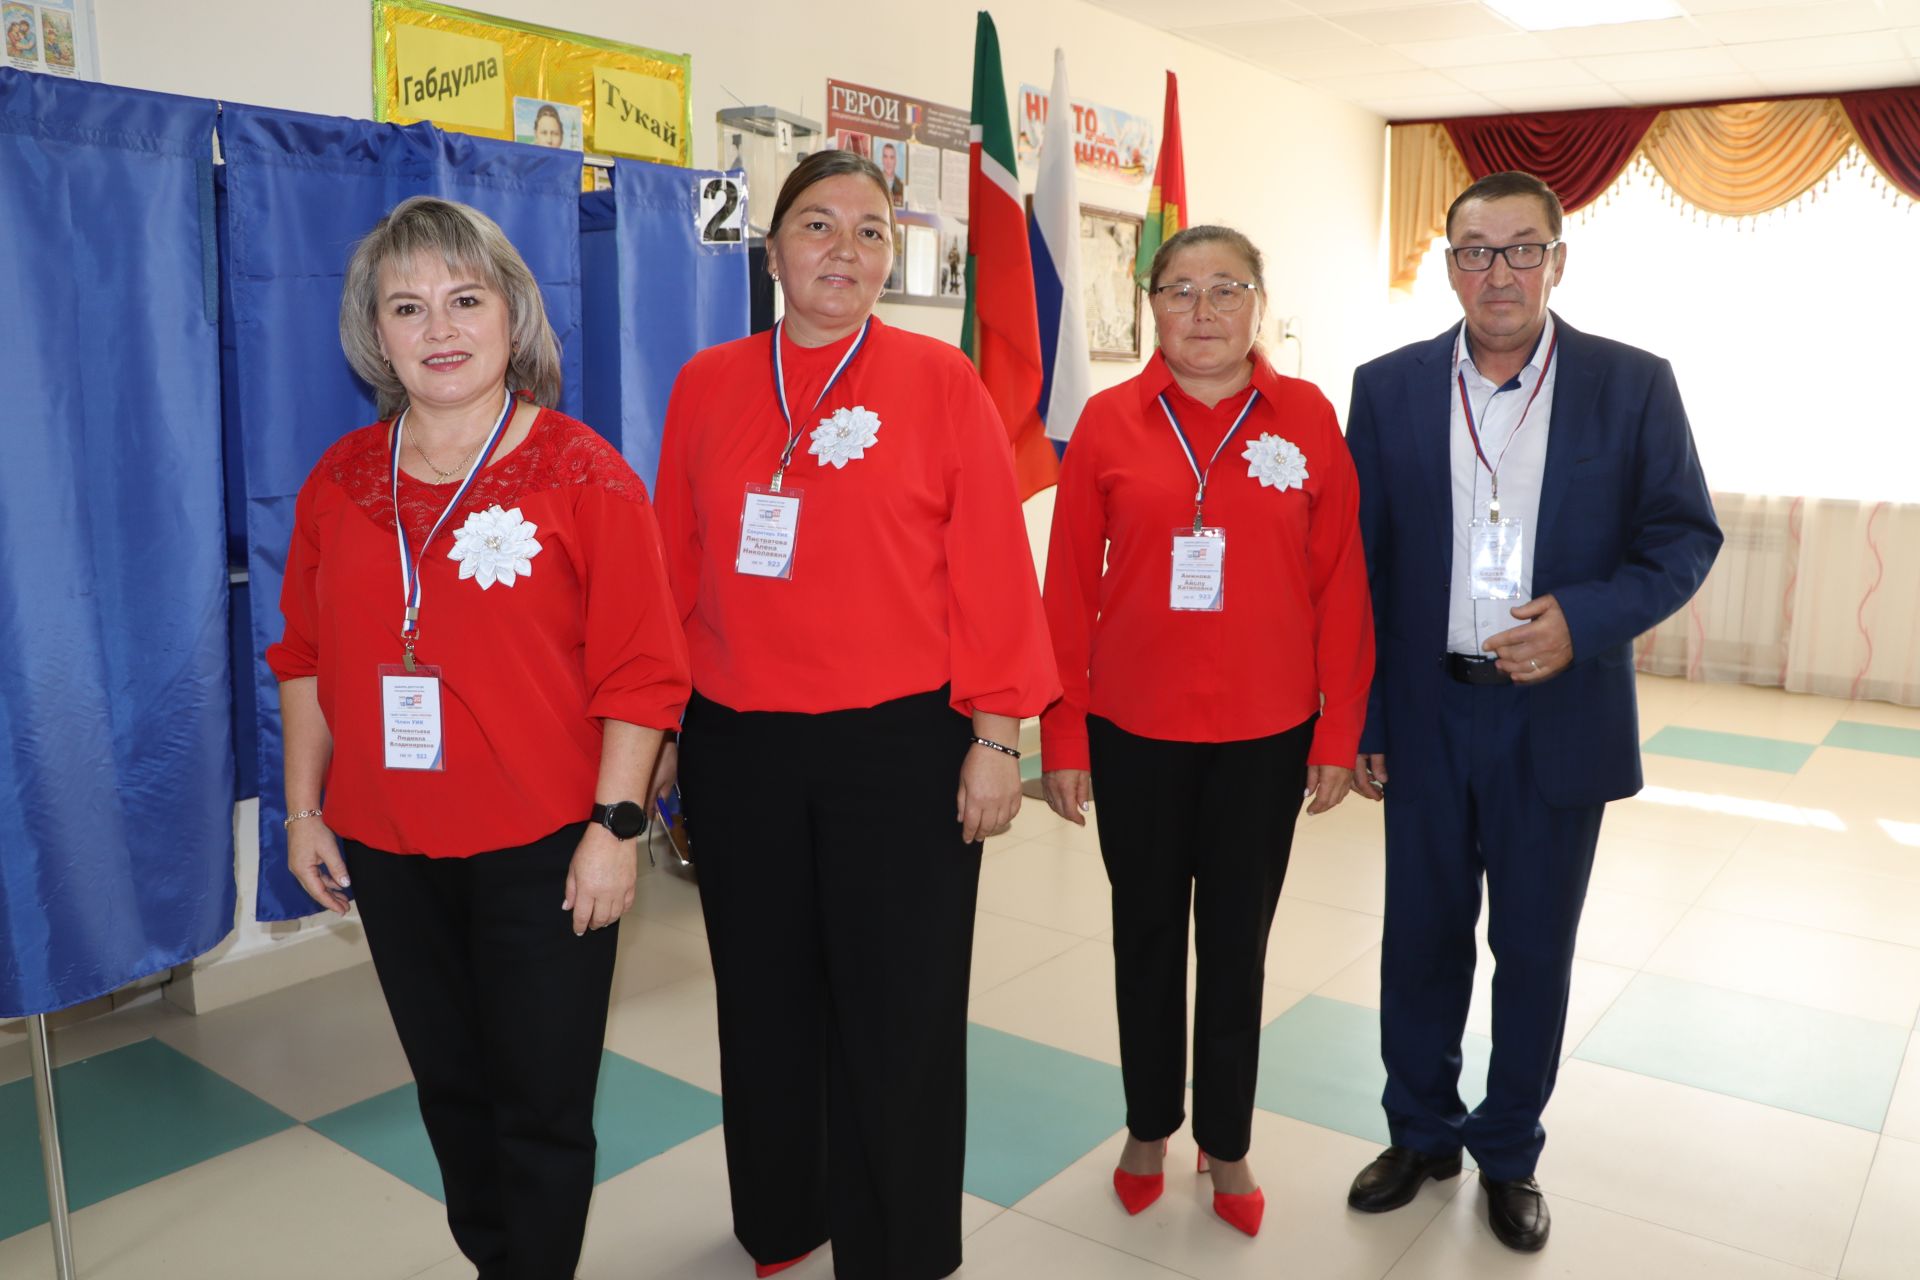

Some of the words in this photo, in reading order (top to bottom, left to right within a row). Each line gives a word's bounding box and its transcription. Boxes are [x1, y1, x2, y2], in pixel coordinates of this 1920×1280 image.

[403, 57, 498, 105] Габдулла
[602, 79, 677, 147] Тукай
[831, 86, 900, 123] ГЕРОИ
[1026, 91, 1097, 134] НТО
[782, 128, 788, 146] 1
[704, 179, 741, 241] 2
